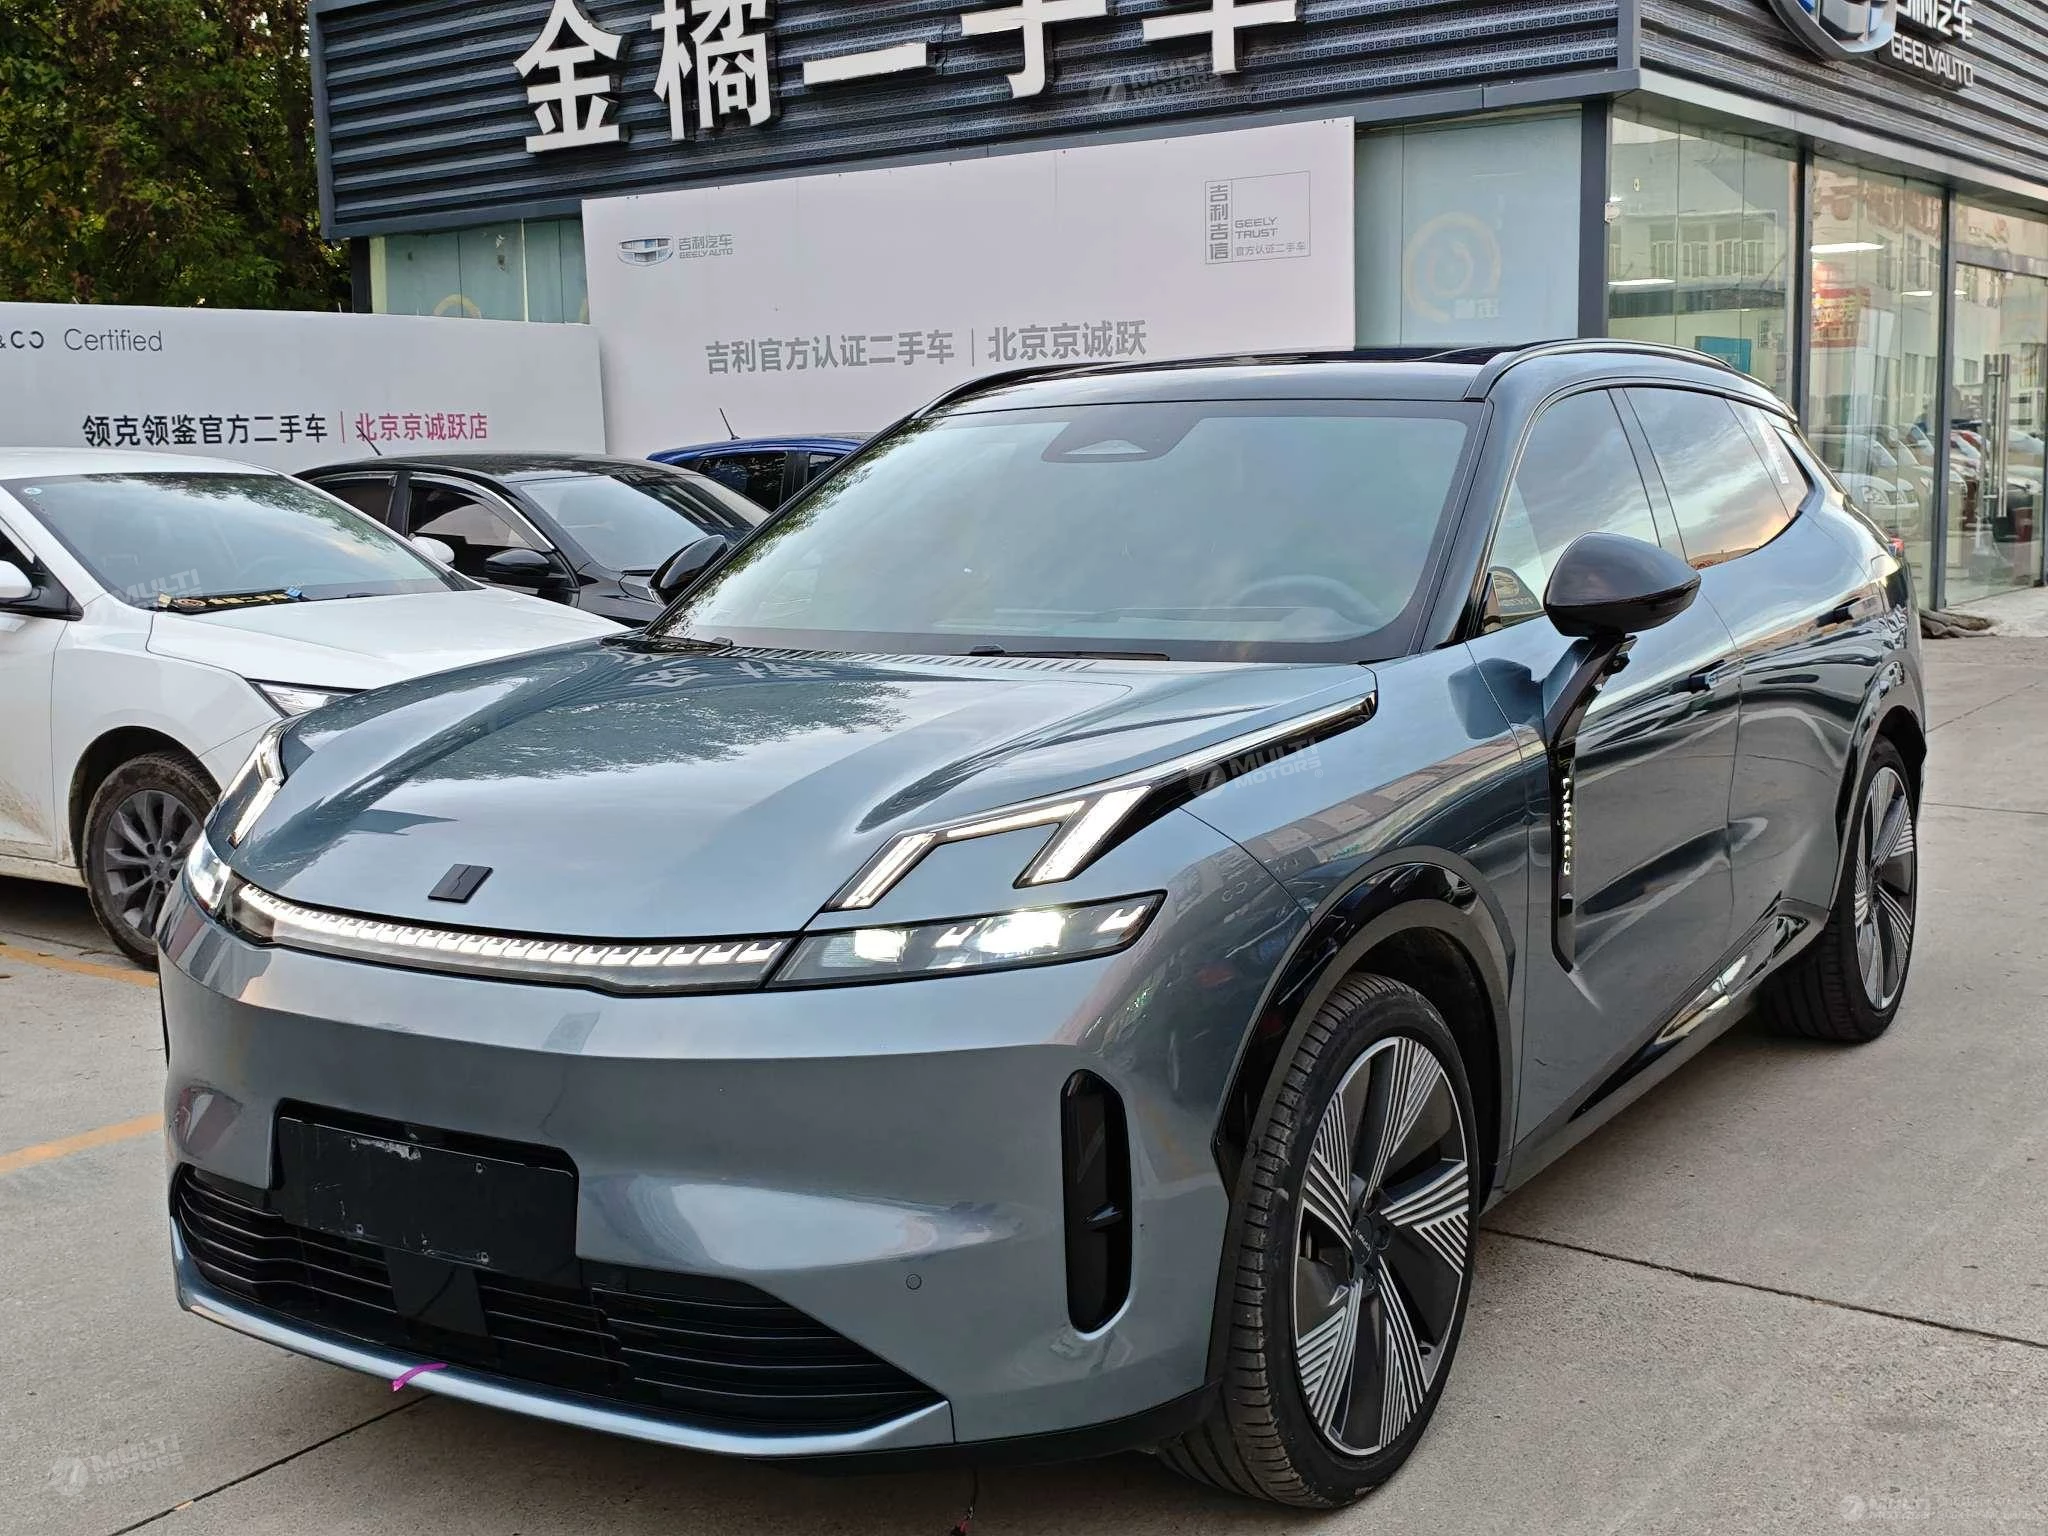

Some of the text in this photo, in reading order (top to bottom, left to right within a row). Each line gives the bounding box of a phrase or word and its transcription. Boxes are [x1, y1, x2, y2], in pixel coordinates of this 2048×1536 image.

[1209, 184, 1229, 260] 吉利吉信
[1234, 217, 1278, 228] GEELY
[1234, 228, 1279, 239] TRUST
[64, 328, 163, 351] Certified
[705, 319, 1147, 374] 吉利官方认证二手车 北京京诚跃
[82, 411, 489, 448] 领克领鉴官方二手车 北京京诚跃店
